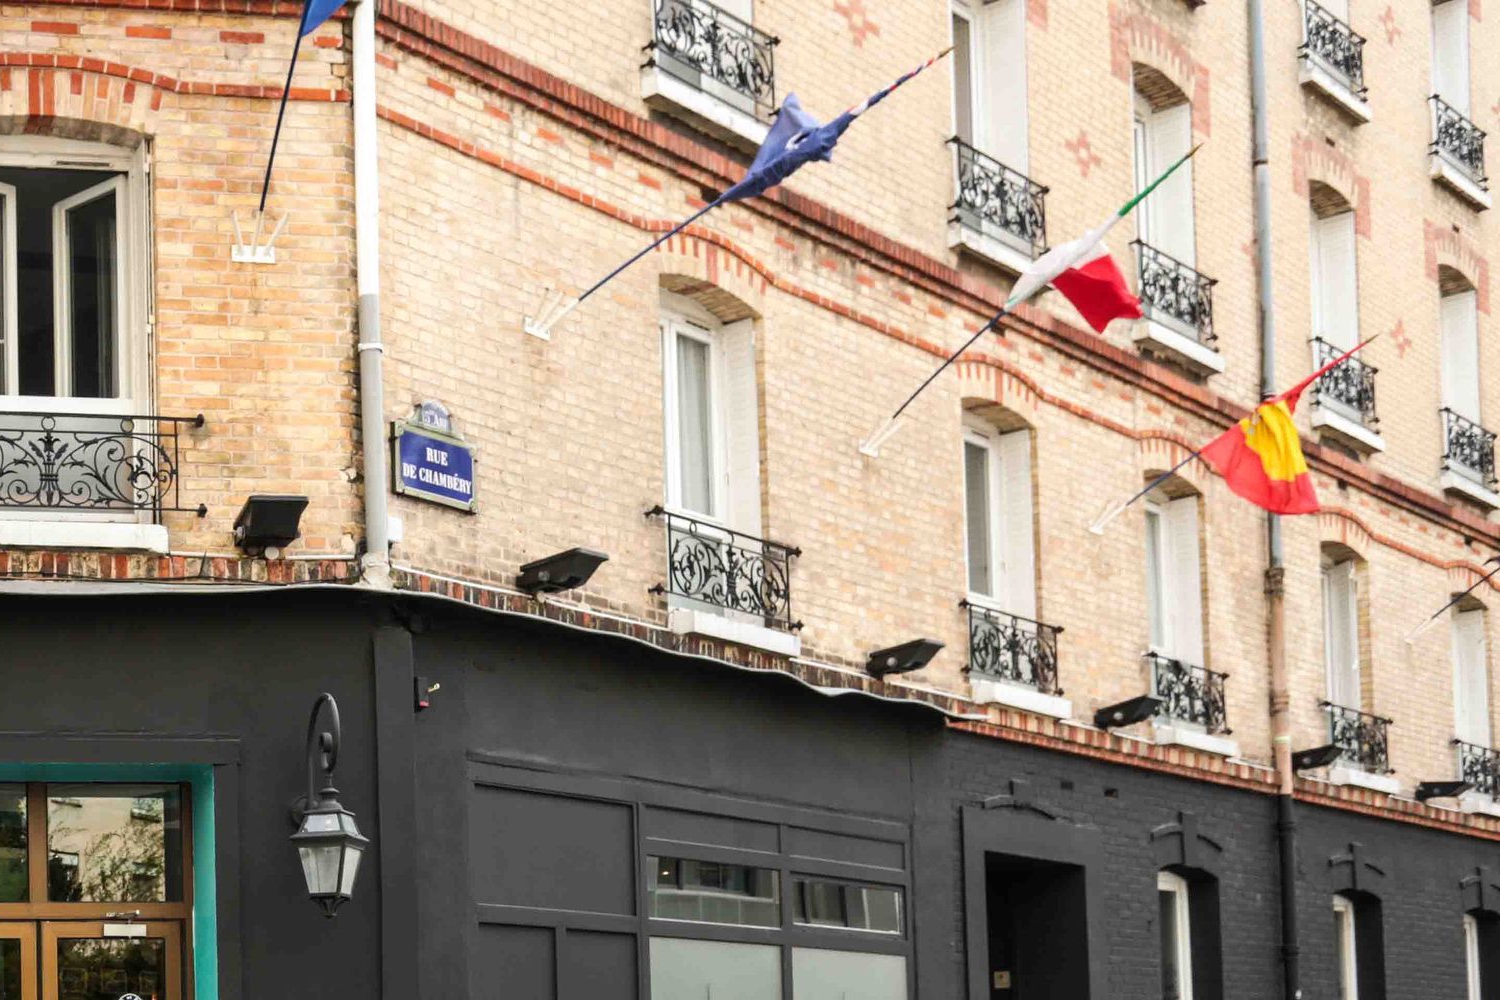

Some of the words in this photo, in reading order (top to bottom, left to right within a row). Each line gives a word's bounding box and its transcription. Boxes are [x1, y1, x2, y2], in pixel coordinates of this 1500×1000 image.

[426, 447, 449, 466] RUE
[402, 462, 417, 480] DE
[418, 467, 472, 495] CHAMBÉRY
